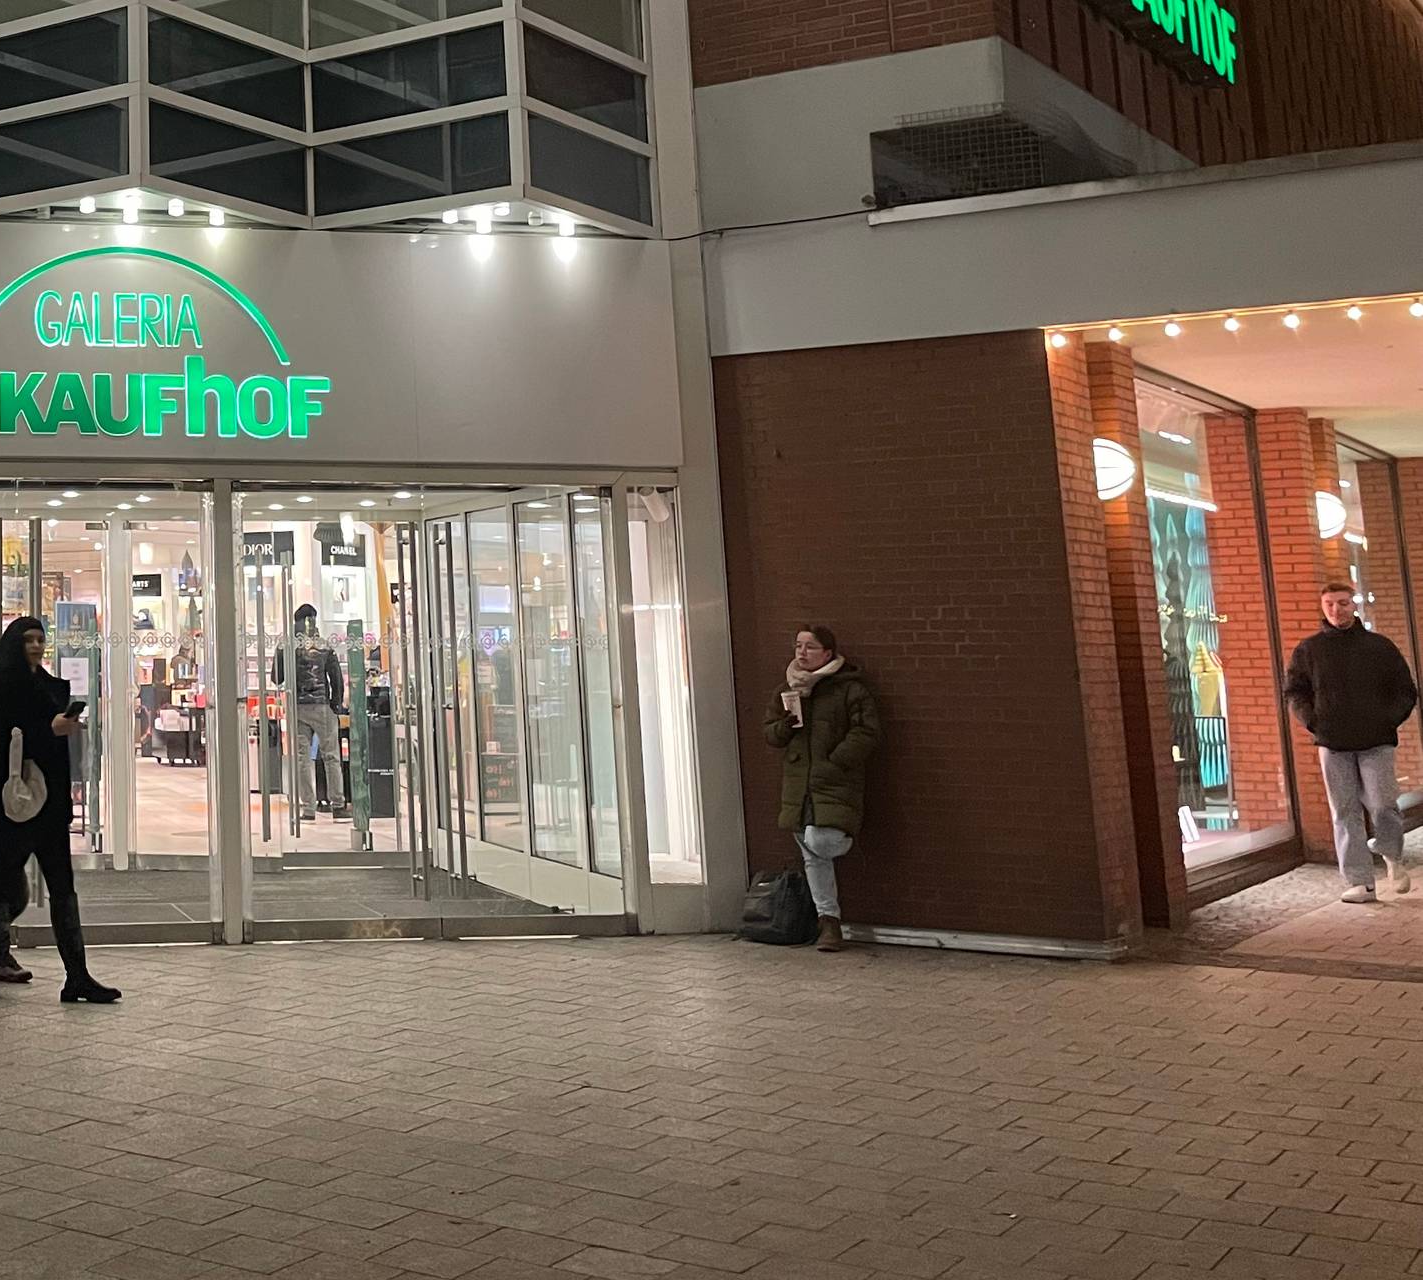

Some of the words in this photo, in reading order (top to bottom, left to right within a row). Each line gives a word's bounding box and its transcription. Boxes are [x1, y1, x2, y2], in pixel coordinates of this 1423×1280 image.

[34, 290, 203, 348] GALERIA
[243, 543, 273, 556] DIOR
[330, 545, 357, 556] CHANEL
